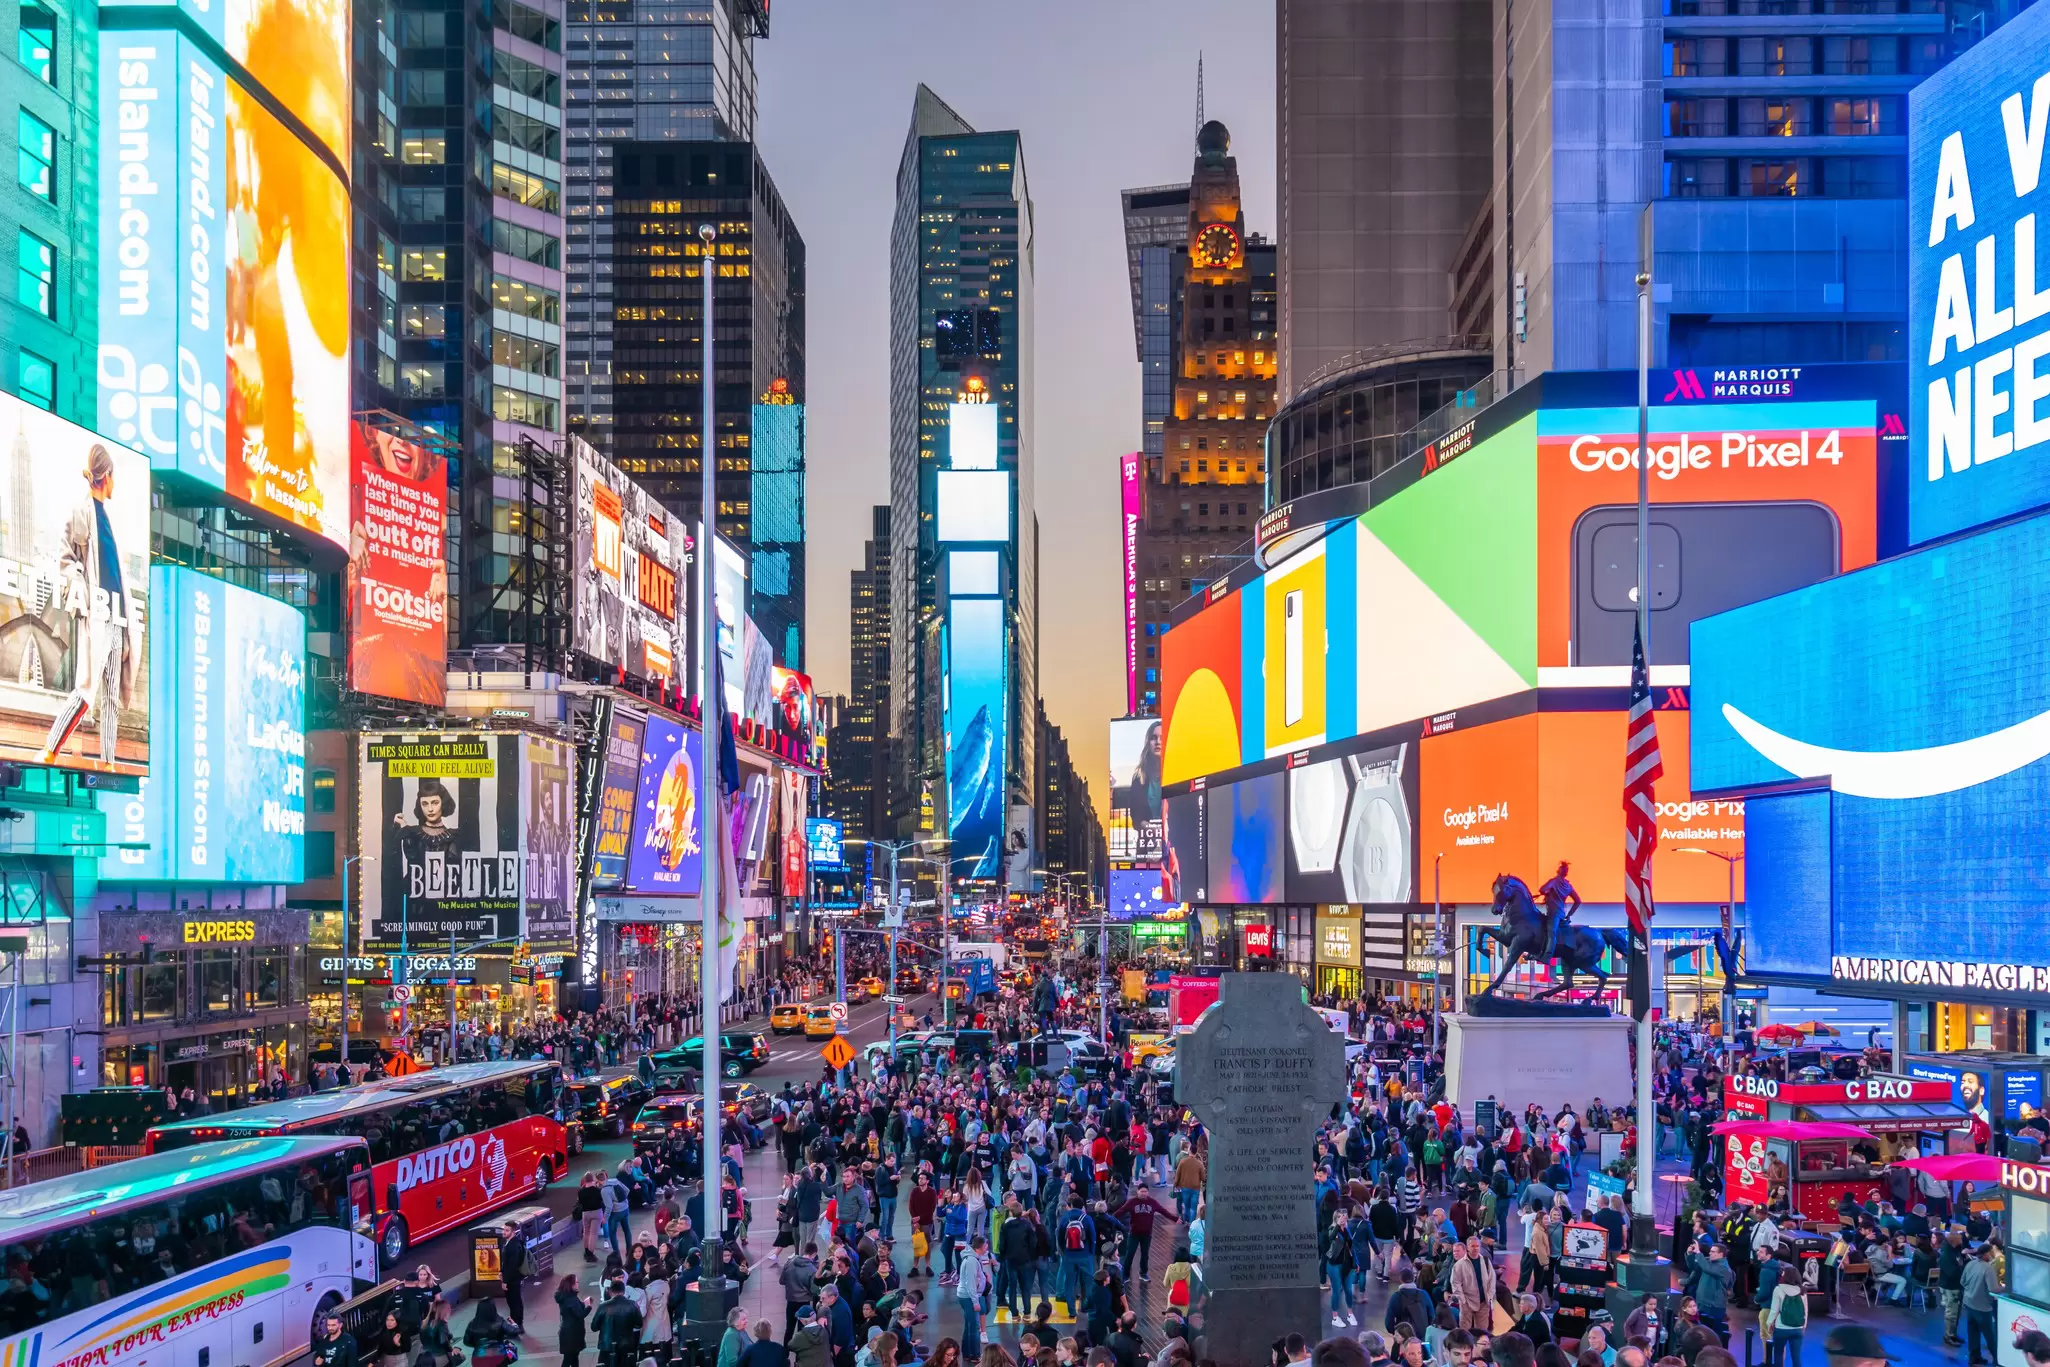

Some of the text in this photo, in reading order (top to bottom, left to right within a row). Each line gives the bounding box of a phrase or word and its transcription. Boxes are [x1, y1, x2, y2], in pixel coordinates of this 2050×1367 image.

[118, 46, 158, 316] Island.com
[1928, 130, 1976, 248] A
[190, 60, 215, 332] Island.com
[1928, 212, 2050, 366] ALL
[1713, 368, 1801, 381] MARRIOTT
[958, 392, 989, 405] 2019
[1713, 382, 1792, 396] MARQUIS
[1439, 420, 1476, 450] MARRIOTT
[1439, 436, 1471, 463] MARQUIS
[1568, 430, 1844, 480] Google Pixel 4
[265, 481, 309, 517] Nassau
[365, 483, 440, 521] last time you
[400, 485, 421, 502] was
[422, 491, 440, 508] the
[365, 498, 440, 536] laughed your
[1260, 503, 1294, 529] MARRIOTT
[365, 514, 440, 558] butt off
[1260, 517, 1289, 541] MARQUIS
[368, 542, 380, 555] at
[382, 546, 389, 557] a
[623, 550, 675, 620] WE HATE
[360, 576, 443, 623] Tootsie
[191, 590, 213, 866] #BahamasStrong
[1433, 712, 1457, 724] MARRIOTT
[731, 711, 808, 765] ROADWAY
[370, 743, 485, 759] TIMES SQUARE CAN REALLY
[391, 762, 493, 775] MAKE YOU FEEL ALIVE!
[583, 757, 597, 813] MAC
[603, 786, 634, 811] COME
[1443, 801, 1509, 830] Google Pixel 4
[1654, 801, 1745, 822] oogle Pix
[575, 817, 589, 873] MAC
[597, 831, 629, 857] AWAY
[1455, 834, 1495, 847] Available Here
[1660, 827, 1718, 840] Available
[409, 853, 519, 899] BEETLE
[437, 901, 450, 910] The
[480, 901, 492, 910] The
[640, 904, 667, 917] Disney
[184, 920, 256, 943] EXPRESS
[440, 920, 463, 932] GOOD
[319, 957, 374, 971] GITS
[1832, 956, 2048, 992] AMERICAN EAGLE
[179, 1044, 209, 1057] EXPRESS
[223, 1038, 250, 1050] EXPRESS
[1220, 1048, 1307, 1056] LIEUTENANT COLONEL
[1214, 1058, 1315, 1069] FRANCIS P DUFFY
[1913, 1068, 1928, 1077] Start
[1219, 1072, 1235, 1080] MAY
[1733, 1074, 1778, 1098] C BAO
[1226, 1084, 1301, 1093] CATHOLIC PRIEST
[1845, 1080, 1912, 1099] C BAO
[1244, 1105, 1284, 1113] CHAPLAIN
[229, 1129, 252, 1137] 75704
[1236, 1127, 1254, 1135] OLD
[1255, 1148, 1265, 1156] OF
[1270, 1148, 1302, 1156] SERVICE
[396, 1137, 476, 1193] DATTCO
[1224, 1164, 1305, 1172] GOD AND COUNTRY
[2002, 1163, 2050, 1194] HOT
[112, 1288, 245, 1356] TOUR EXPRESS
